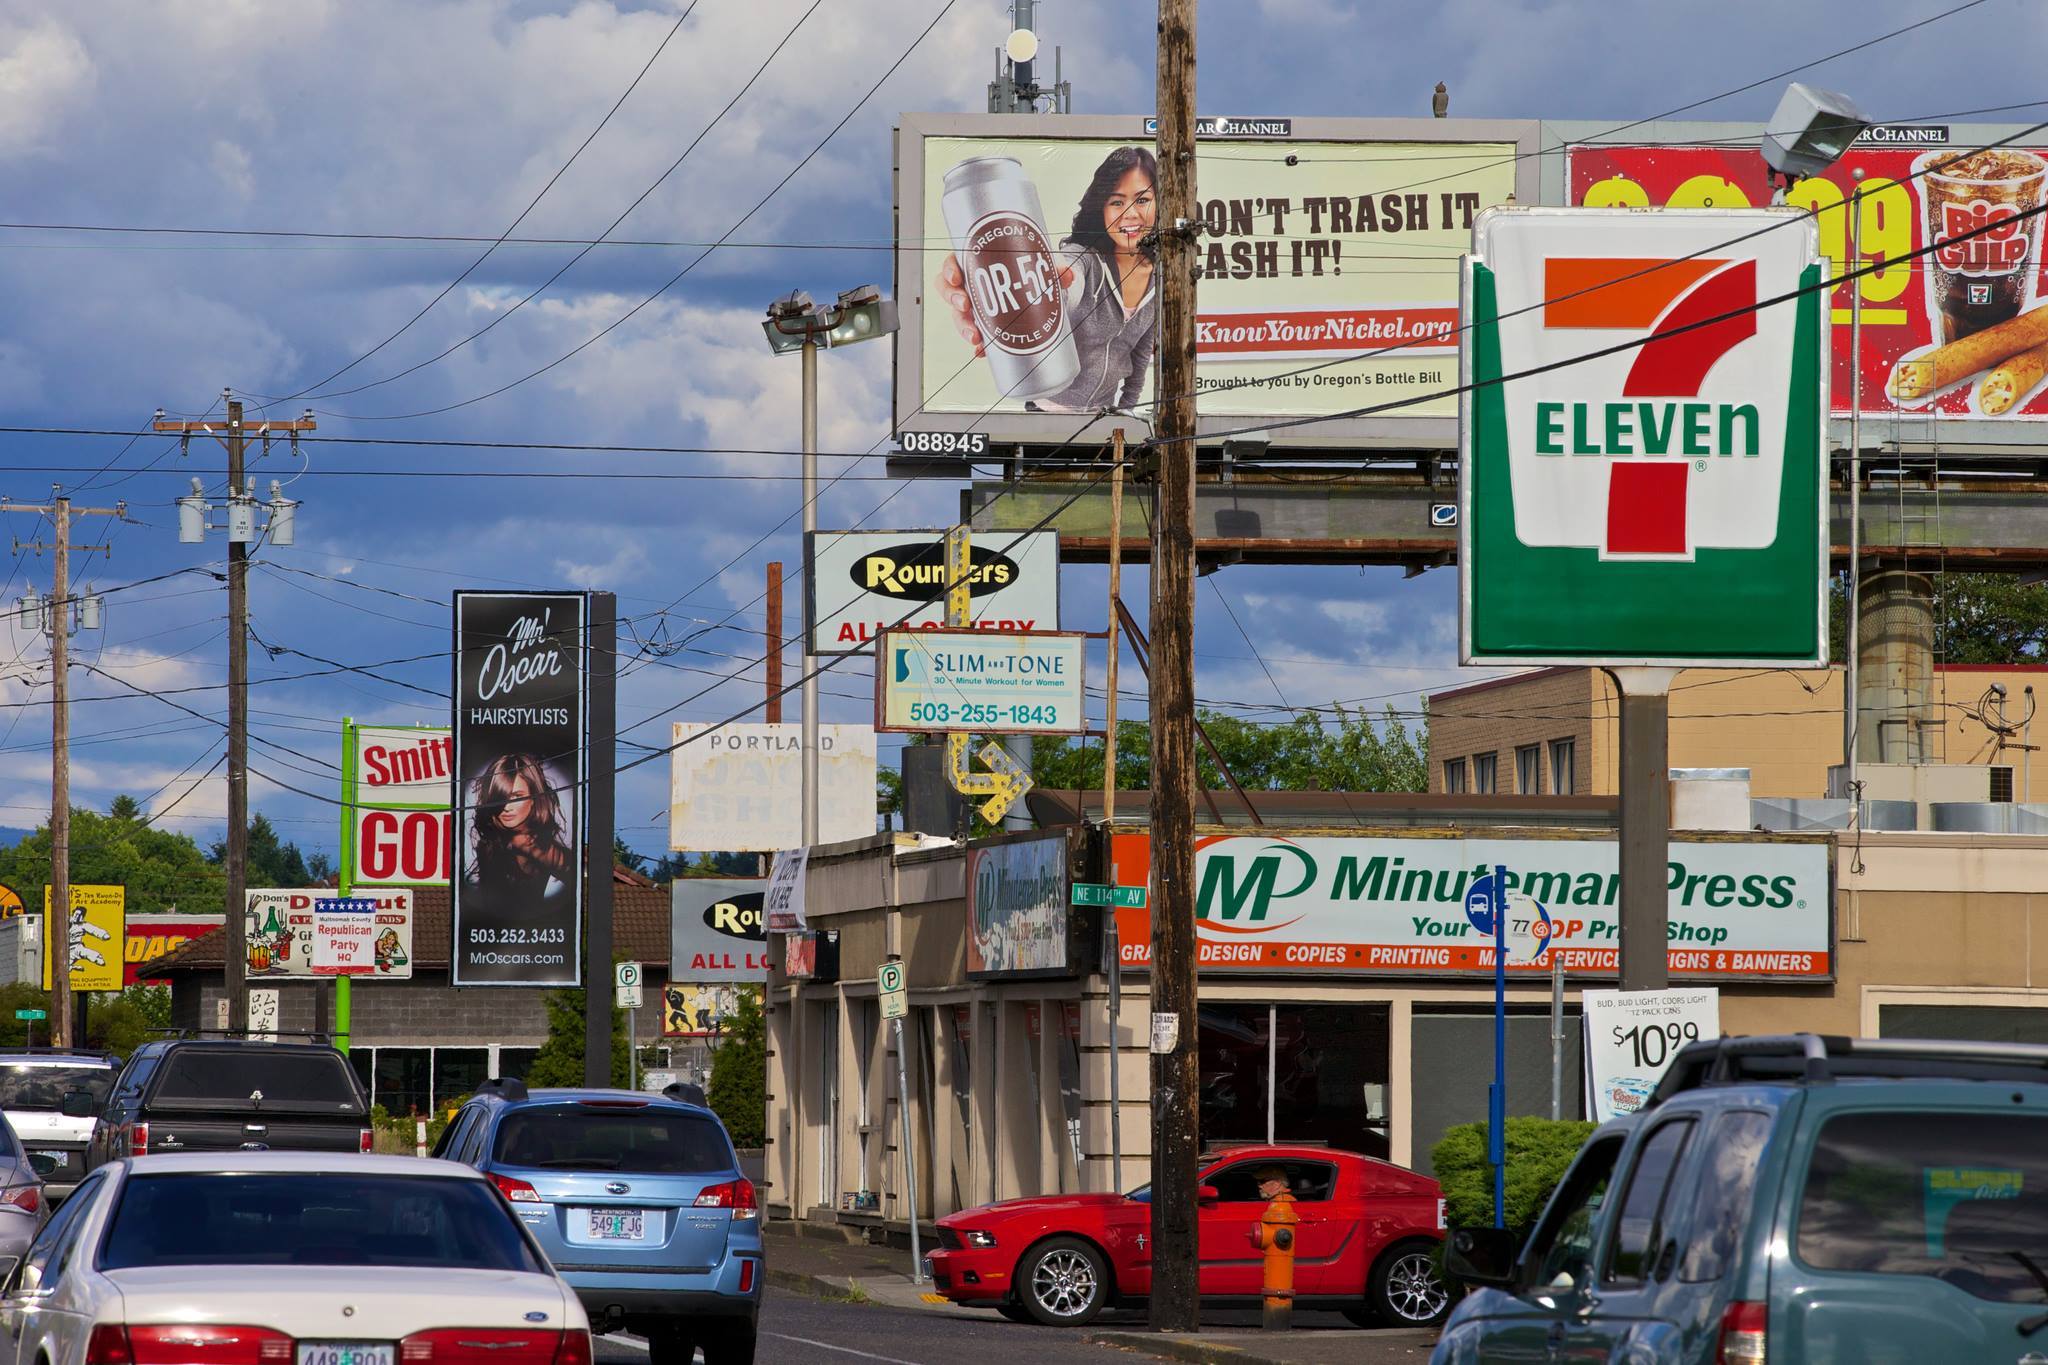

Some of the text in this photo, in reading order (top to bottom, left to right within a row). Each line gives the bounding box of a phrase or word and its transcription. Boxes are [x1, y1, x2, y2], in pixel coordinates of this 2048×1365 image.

[1196, 118, 1288, 135] ARCHANNEL
[1303, 193, 1429, 233] TRASH
[1441, 192, 1480, 230] IT
[972, 226, 1036, 256] OREGON'S
[1196, 239, 1342, 280] ASH IT!
[1937, 237, 2026, 271] GULP
[995, 309, 1058, 344] BOTTLE BILL
[1196, 317, 1453, 343] KnowYourNickel.org
[1251, 377, 1265, 387] to
[1268, 378, 1291, 390] you
[1295, 374, 1309, 388] by
[1313, 373, 1372, 388] Oregon's
[1375, 372, 1415, 385] Bottle
[1419, 371, 1442, 384] Bill
[903, 432, 984, 453] 088945
[866, 556, 1010, 592] Rouners
[934, 653, 985, 673] SLIM
[1005, 655, 1063, 674] TONE
[478, 644, 562, 701] Oscar
[934, 676, 1065, 687] 30 Minute Workout for Women
[471, 708, 569, 725] HAIRSTYLISTS
[910, 703, 1057, 724] 503-255-1843
[710, 735, 835, 750] PORTLAD
[263, 894, 289, 903] Don's
[289, 894, 406, 910] Dut
[1077, 887, 1089, 901] NE
[1127, 890, 1140, 904] AV
[318, 924, 372, 936] Republican
[1411, 916, 1472, 938] Your
[1588, 920, 1620, 940] Pri
[1667, 921, 1729, 946] Shop
[1512, 919, 1530, 933] 77
[470, 928, 565, 944] 503.252.3433
[330, 939, 360, 953] Party
[337, 953, 352, 962] HQ
[470, 951, 564, 965] MrOscars.com
[690, 953, 736, 969] ALL
[1200, 944, 1262, 963] DESIGN
[1285, 945, 1347, 963] COPIES
[1370, 947, 1450, 966] PRINTING
[1669, 952, 1709, 970] IGNS
[1715, 954, 1727, 971] &
[1732, 952, 1812, 972] BANNERS
[625, 969, 634, 981] P
[887, 971, 897, 986] P
[1597, 999, 1616, 1008] BUD,
[1618, 998, 1633, 1007] BUD
[1635, 997, 1660, 1006] LIGHT,
[1687, 995, 1708, 1004] LIGHT
[1642, 1007, 1661, 1016] PACK
[1663, 1007, 1681, 1015] CANS
[591, 1216, 613, 1231] 549
